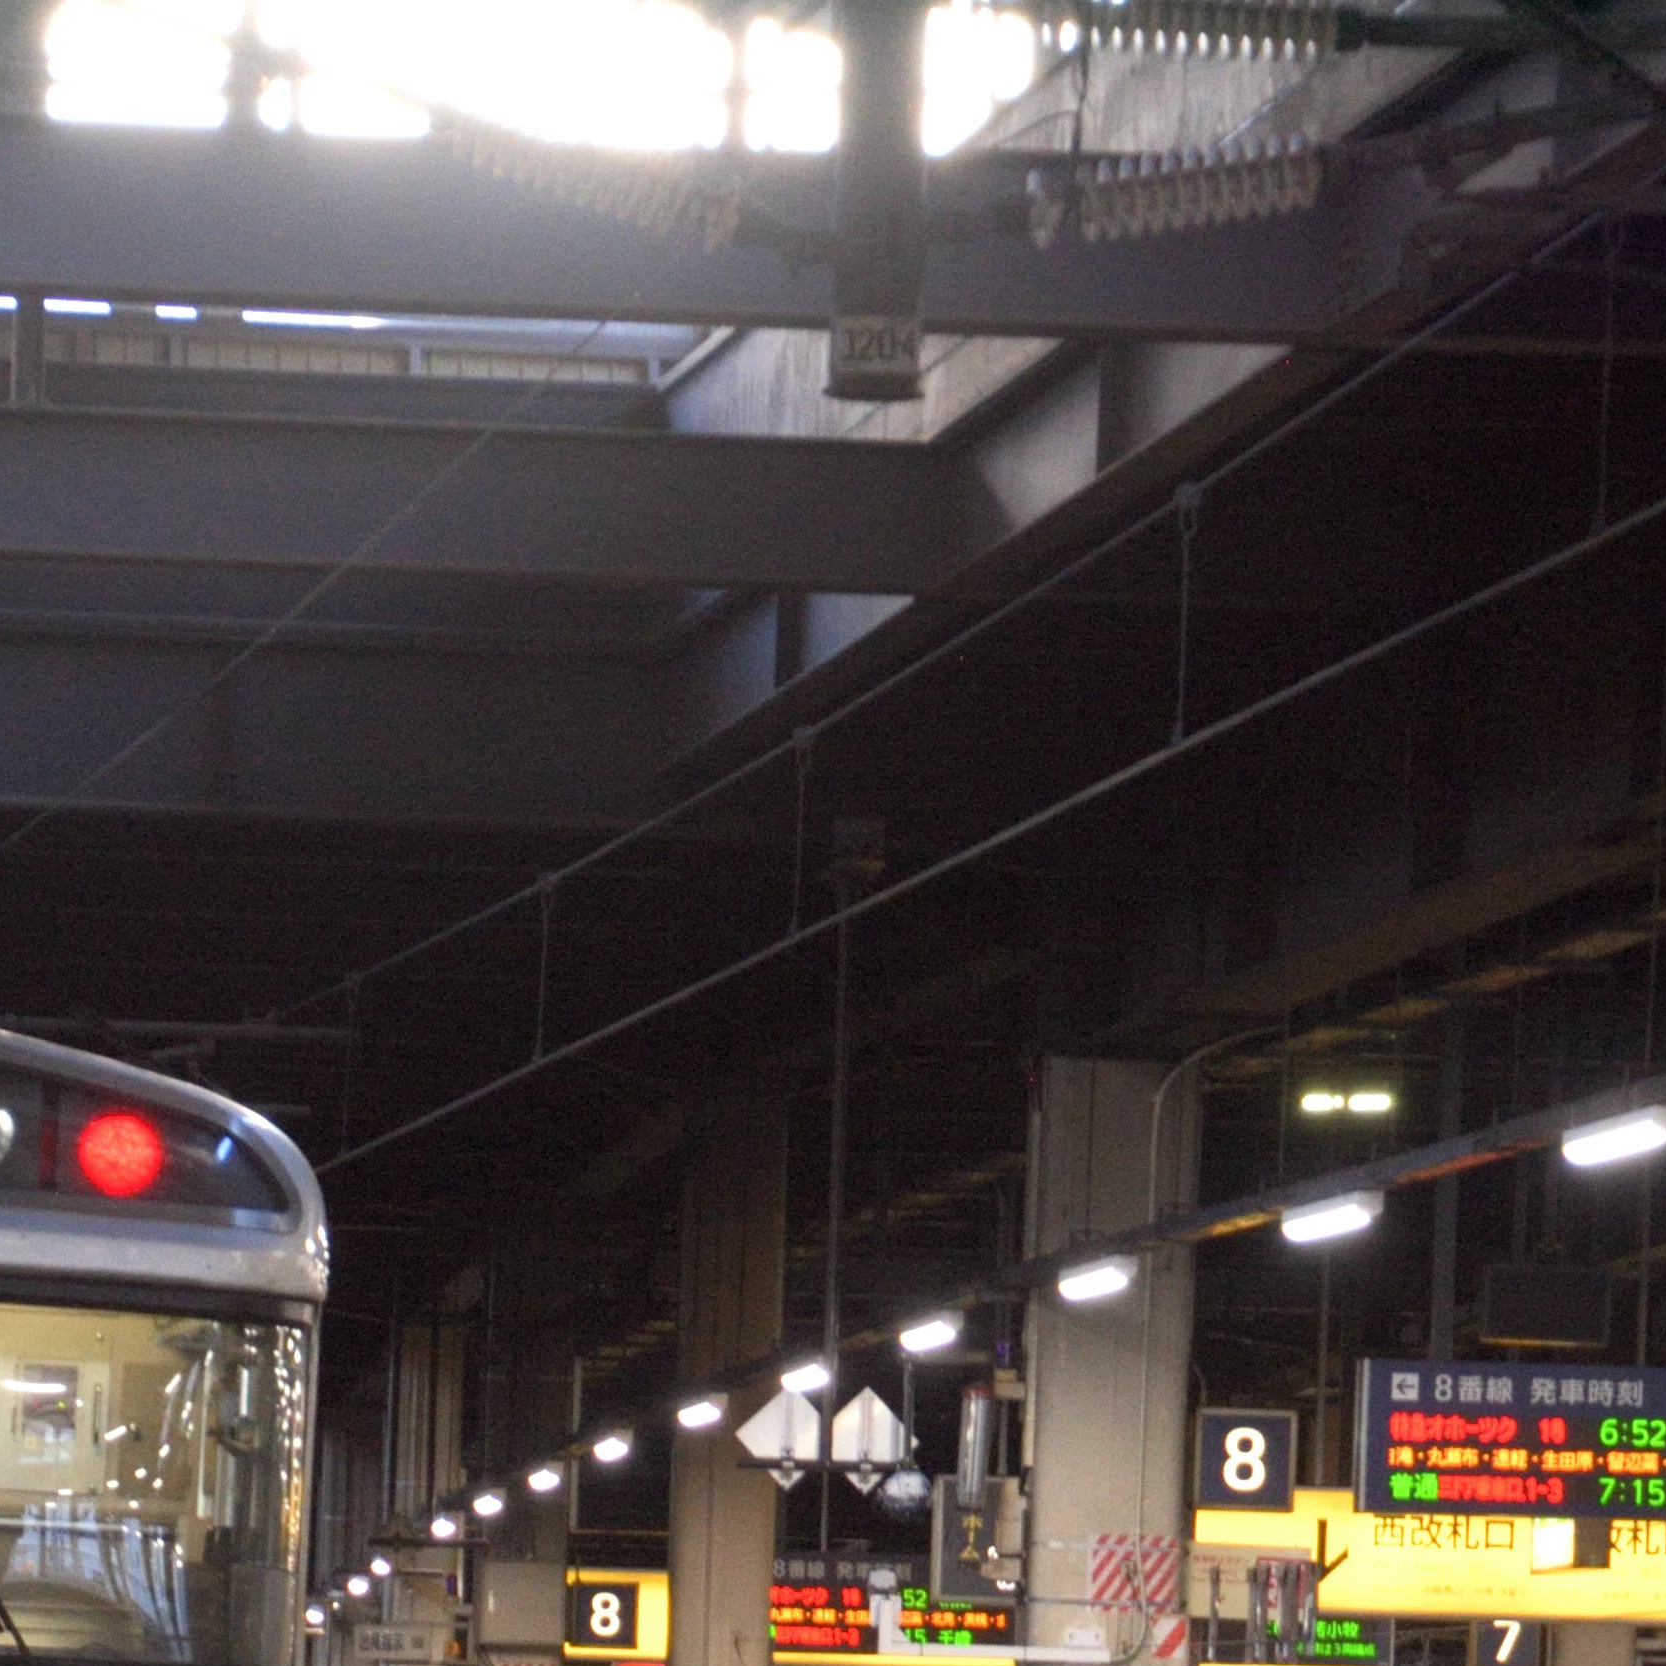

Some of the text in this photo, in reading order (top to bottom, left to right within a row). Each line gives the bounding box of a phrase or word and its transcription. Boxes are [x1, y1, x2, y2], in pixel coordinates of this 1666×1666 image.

[1599, 1416, 1666, 1448] 6:52
[1222, 1426, 1266, 1492] 8
[1597, 1477, 1666, 1507] 7:15
[1374, 1514, 1515, 1551] 西改札口
[590, 1591, 621, 1636] 8
[1493, 1620, 1520, 1662] 7
